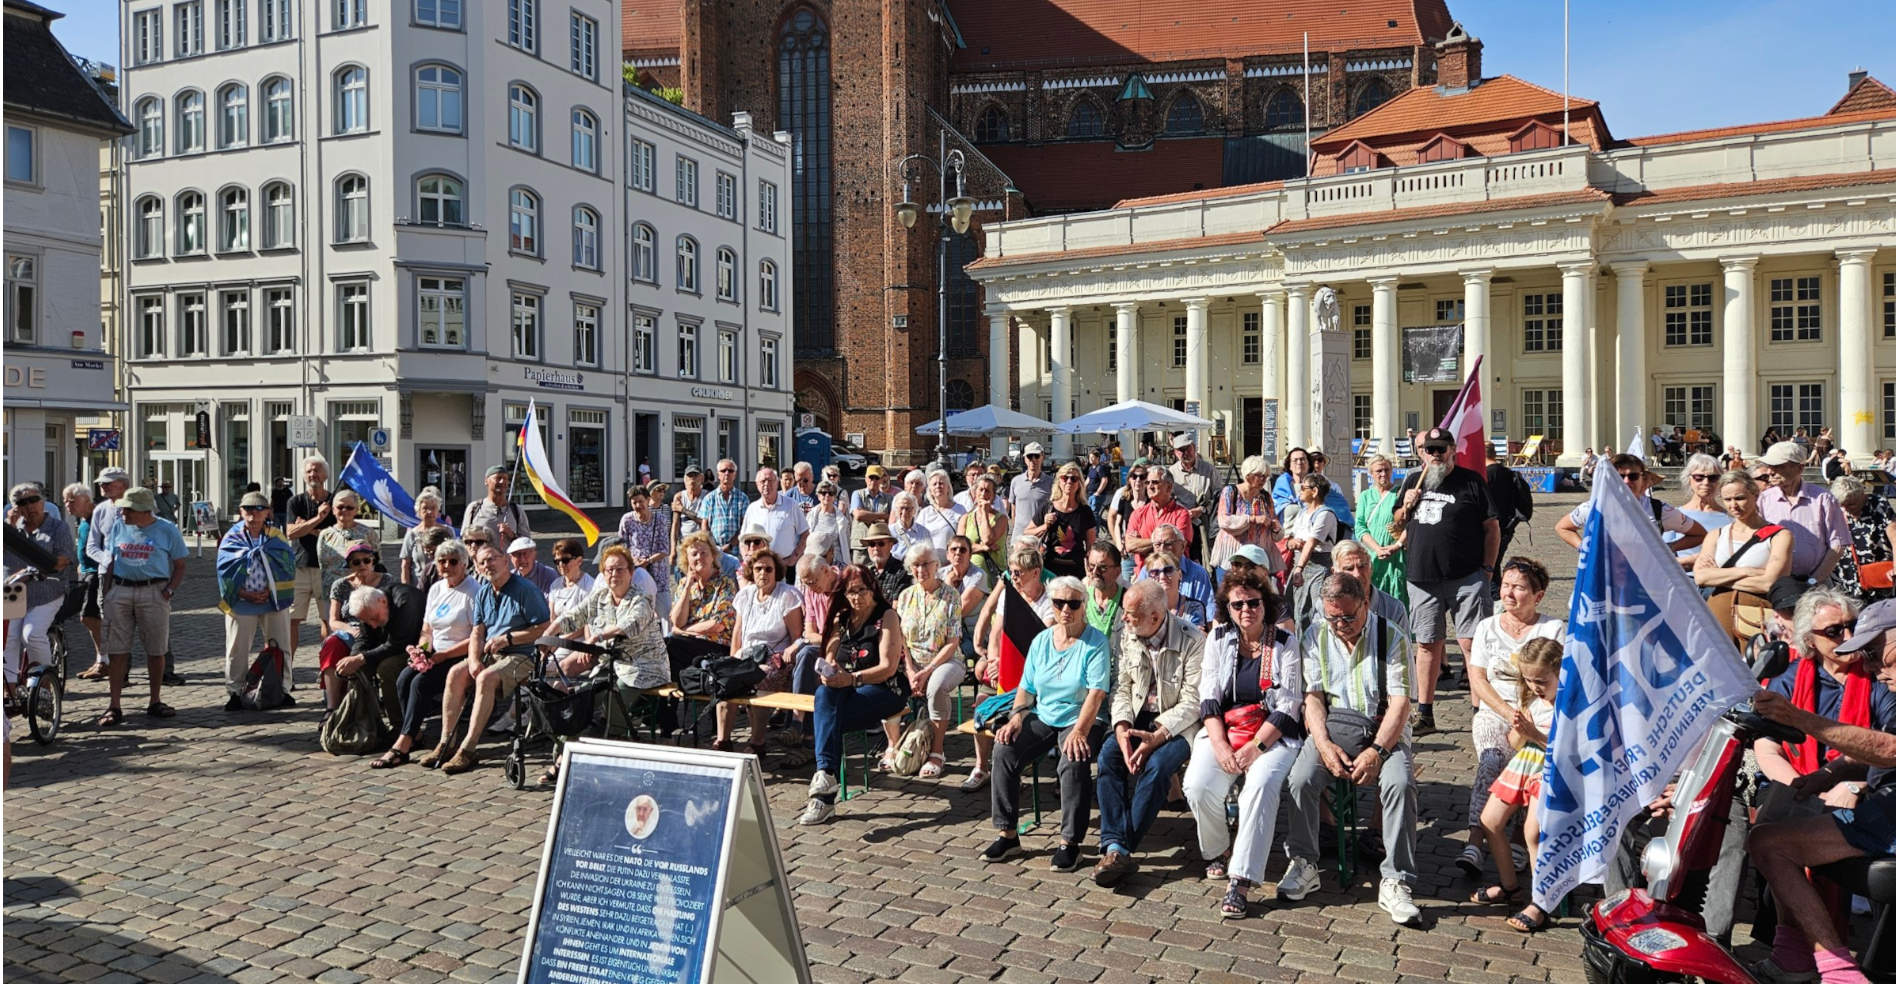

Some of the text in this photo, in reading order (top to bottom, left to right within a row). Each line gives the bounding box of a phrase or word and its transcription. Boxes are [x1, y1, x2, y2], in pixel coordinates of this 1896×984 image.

[4, 365, 47, 388] DE
[524, 367, 576, 384] Papierhaus
[616, 865, 634, 876] PUTIN
[634, 868, 650, 878] DAZU
[654, 859, 668, 869] VOR
[669, 862, 708, 875] RUSSLANDS
[557, 901, 569, 911] DES
[570, 903, 598, 916] WESTENS
[599, 908, 613, 918] SEHR
[614, 910, 630, 922] DAZU
[582, 894, 597, 904] ABER
[636, 903, 651, 913] DASS
[616, 923, 629, 933] UND
[584, 940, 600, 951] GEHT
[600, 944, 608, 953] ES
[608, 945, 618, 954] UM
[626, 936, 640, 947] UND
[670, 945, 687, 956] VON
[540, 956, 556, 967] DASS
[588, 964, 608, 977] STAAT
